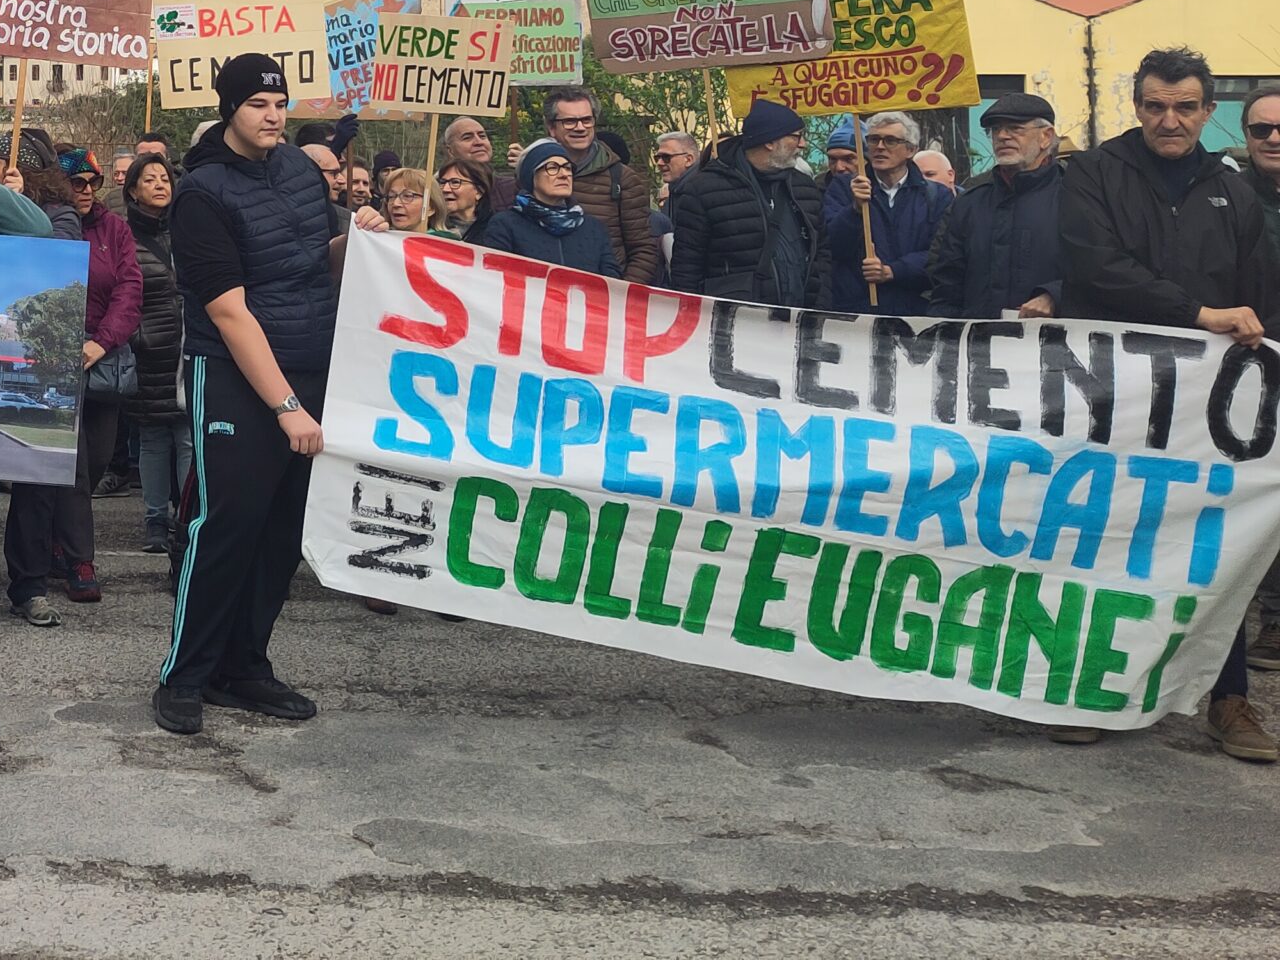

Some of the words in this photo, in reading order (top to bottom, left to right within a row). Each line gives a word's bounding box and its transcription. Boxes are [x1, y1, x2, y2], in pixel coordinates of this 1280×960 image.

[198, 5, 296, 39] BASTA
[326, 14, 351, 32] ma
[674, 0, 736, 23] NON
[56, 26, 149, 60] storica
[328, 20, 375, 48] nario
[379, 24, 460, 60] VERDE
[512, 33, 580, 53] ificazione
[832, 15, 916, 51] ESCO
[328, 39, 376, 70] VEND
[510, 55, 535, 74] stri
[537, 54, 575, 74] COLLI
[170, 50, 315, 93] CEMTO
[340, 62, 374, 89] PRE
[372, 63, 399, 102] NO
[402, 64, 506, 109] CEMENTO
[768, 64, 788, 87] A
[794, 55, 918, 84] QUALCUNO
[336, 86, 371, 110] SPE
[780, 79, 897, 110] SFUGGITO
[378, 237, 702, 384] STOP
[709, 304, 1280, 461] CEMENTO
[348, 462, 446, 580] NEI
